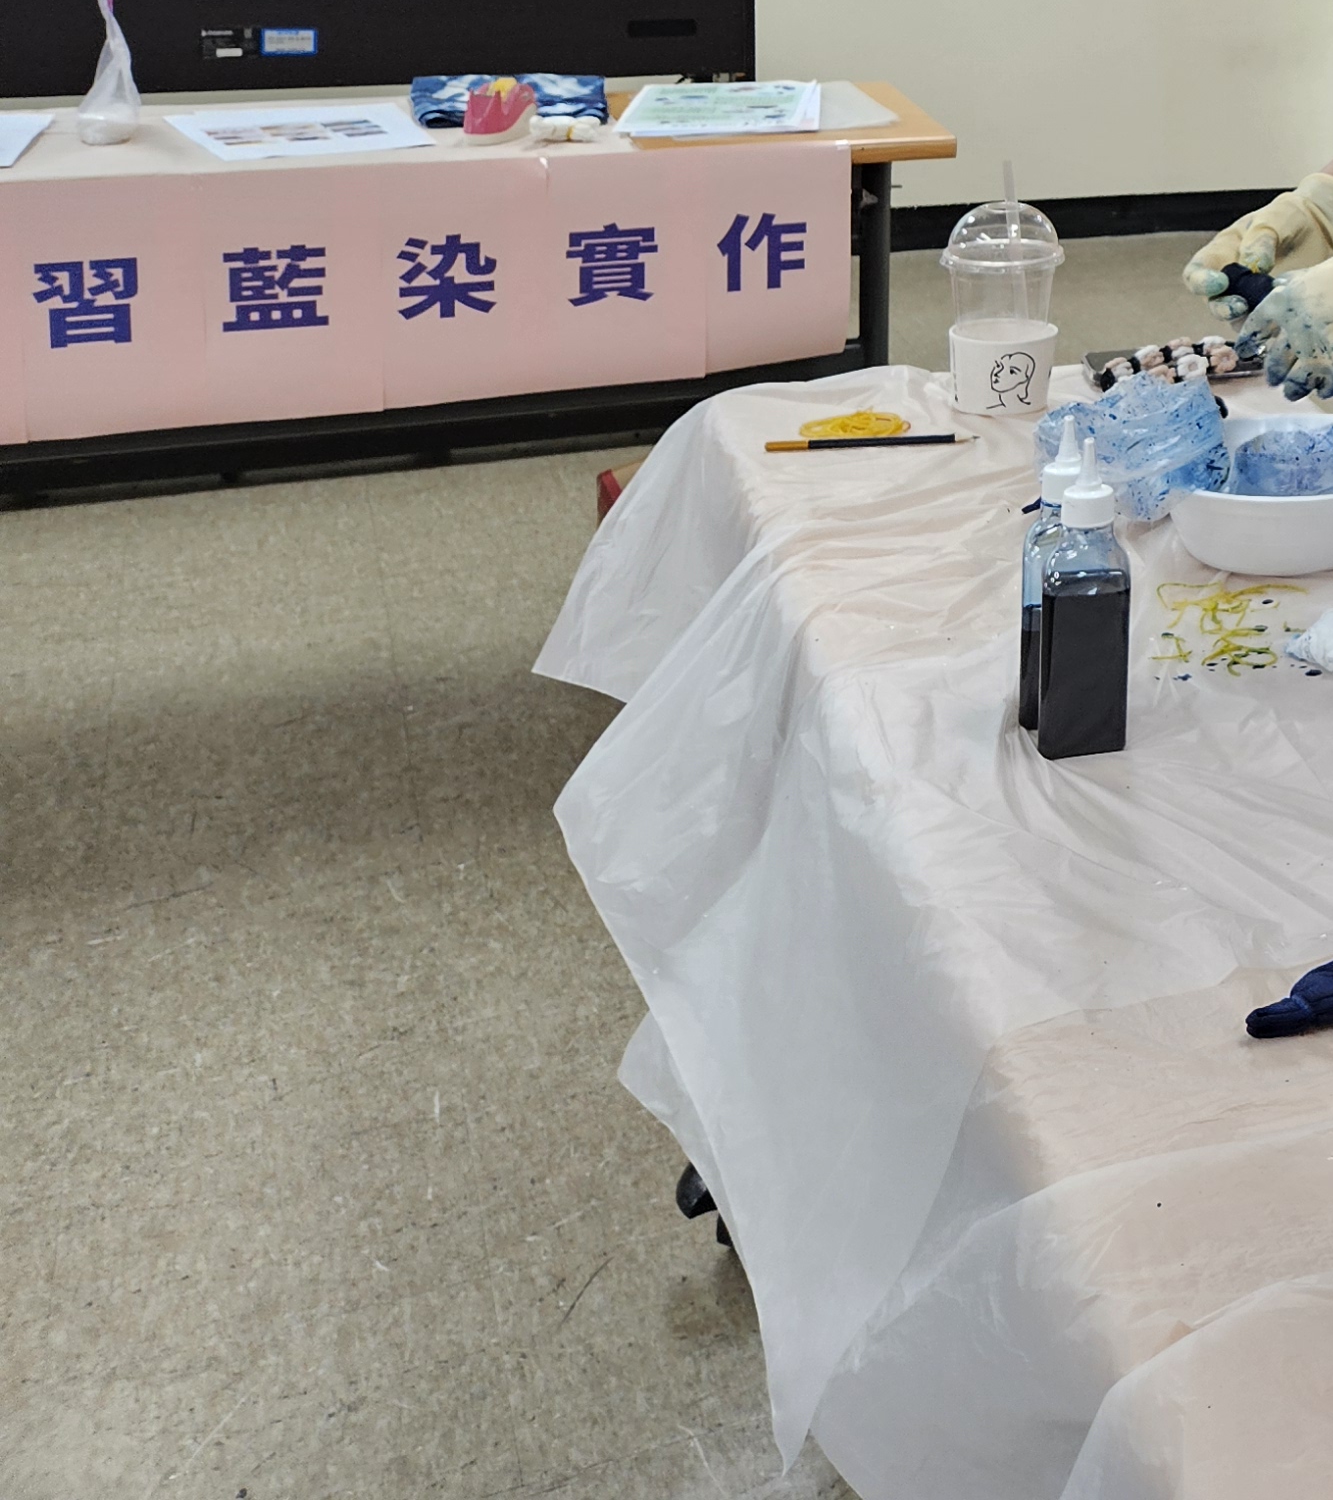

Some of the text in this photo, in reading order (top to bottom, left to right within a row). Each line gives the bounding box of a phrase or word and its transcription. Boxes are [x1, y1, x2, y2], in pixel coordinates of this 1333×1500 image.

[32, 213, 808, 349] 習藍染實作
